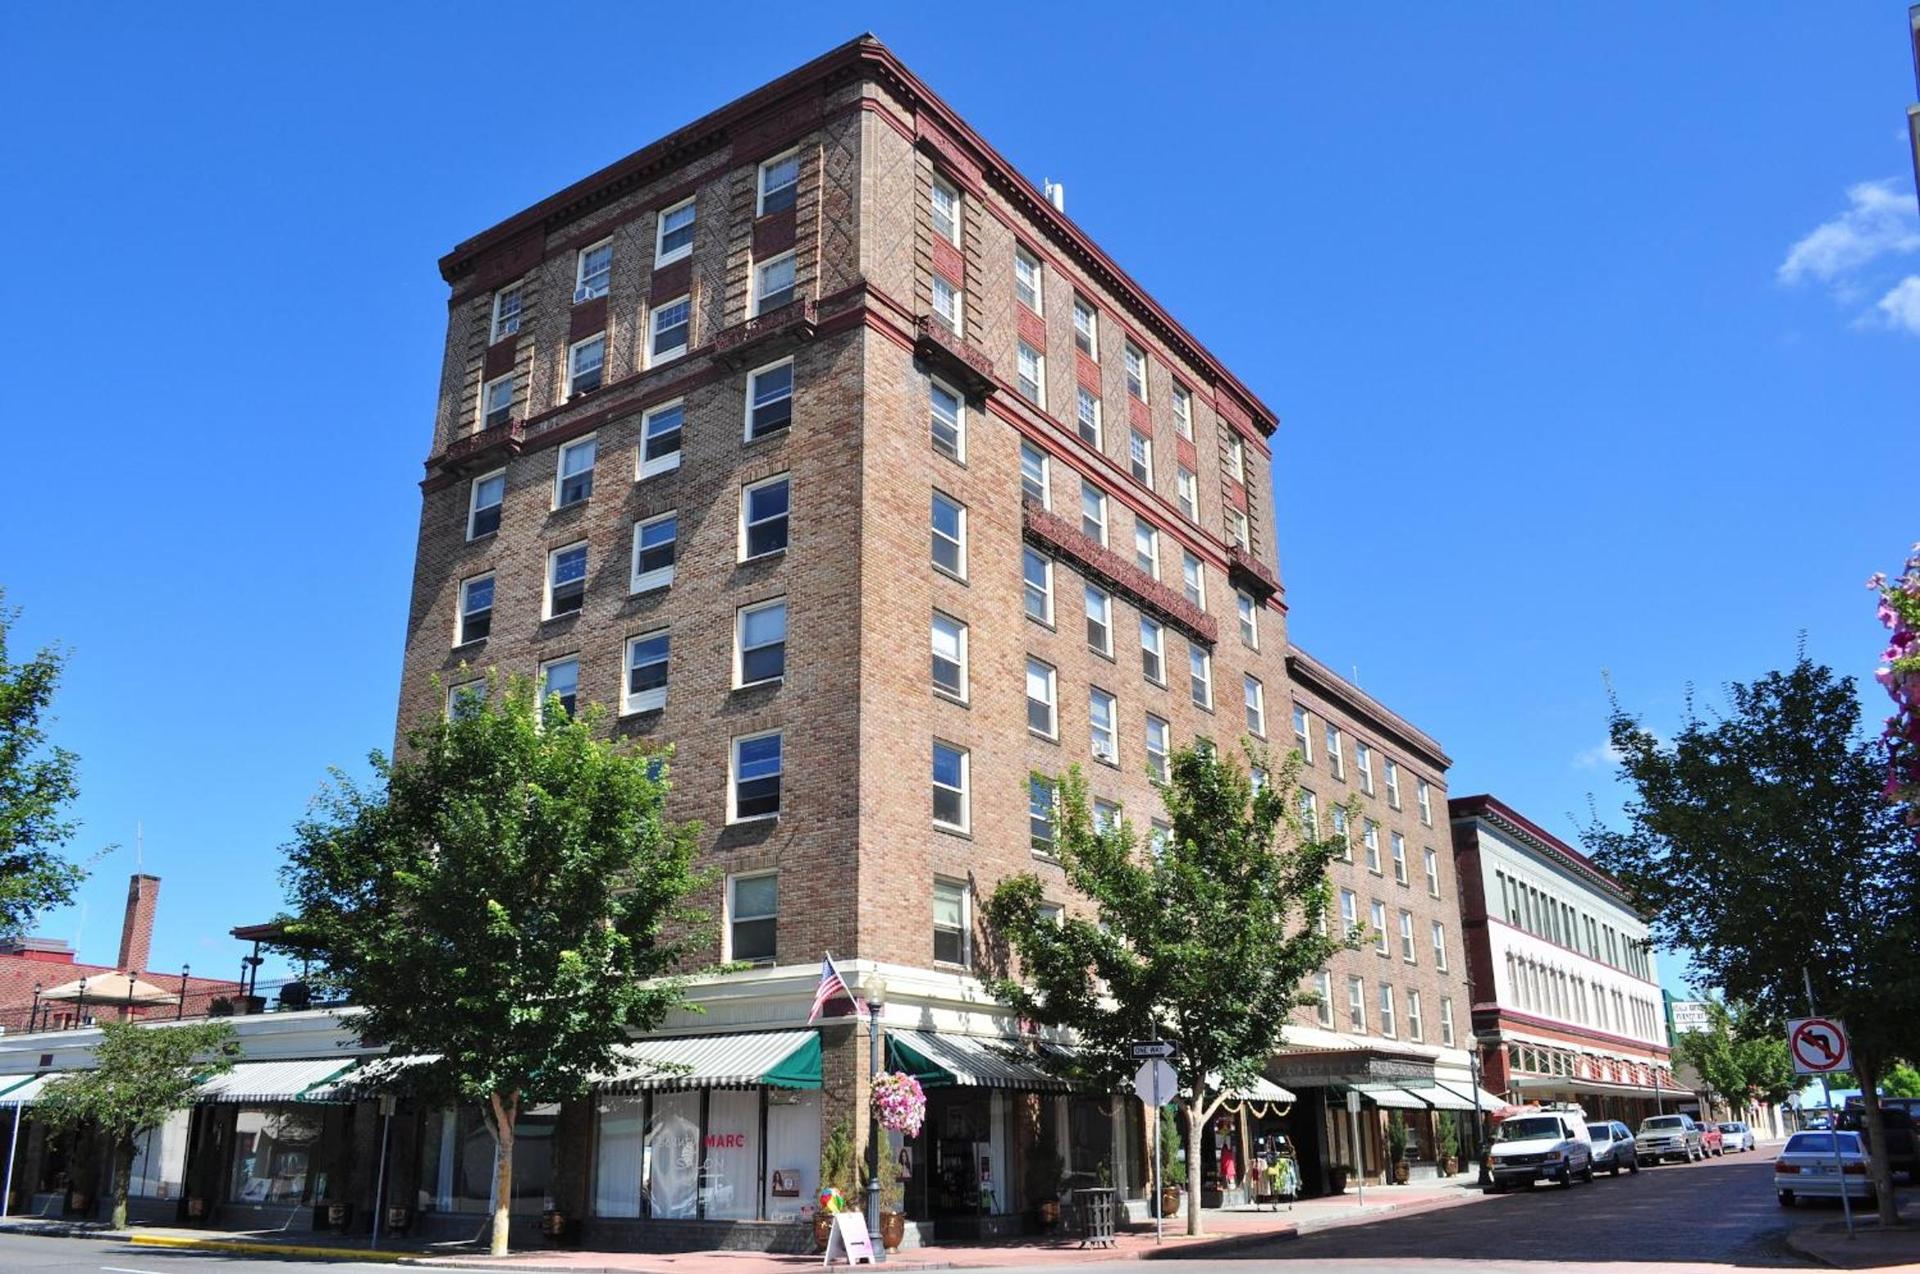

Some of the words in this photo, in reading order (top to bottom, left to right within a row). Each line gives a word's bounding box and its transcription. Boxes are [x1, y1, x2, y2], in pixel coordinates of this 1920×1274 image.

[1134, 1046, 1147, 1054] ONE
[1150, 1046, 1163, 1054] WAY
[703, 1134, 744, 1148] MARC
